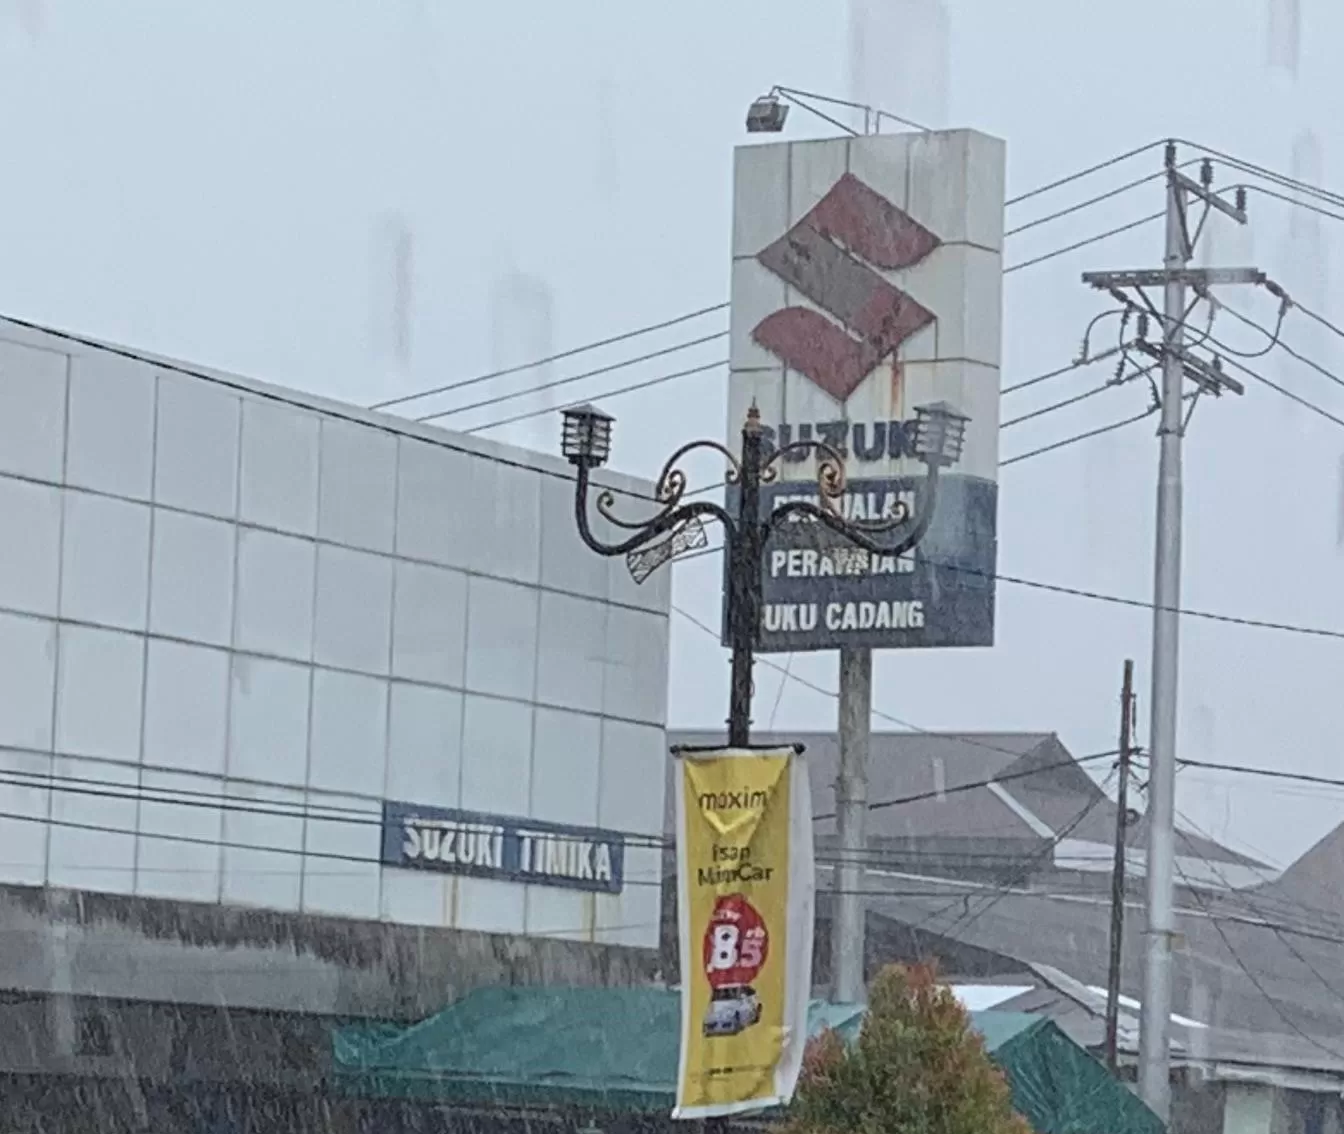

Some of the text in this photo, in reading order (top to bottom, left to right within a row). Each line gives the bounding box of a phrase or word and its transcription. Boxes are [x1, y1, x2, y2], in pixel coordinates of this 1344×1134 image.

[757, 420, 932, 463] UZUK
[771, 547, 915, 578] PERAWTAN
[761, 600, 925, 632] UKU CADANG
[698, 785, 768, 810] maxim
[403, 817, 612, 881] SUZUKI TIMIKA
